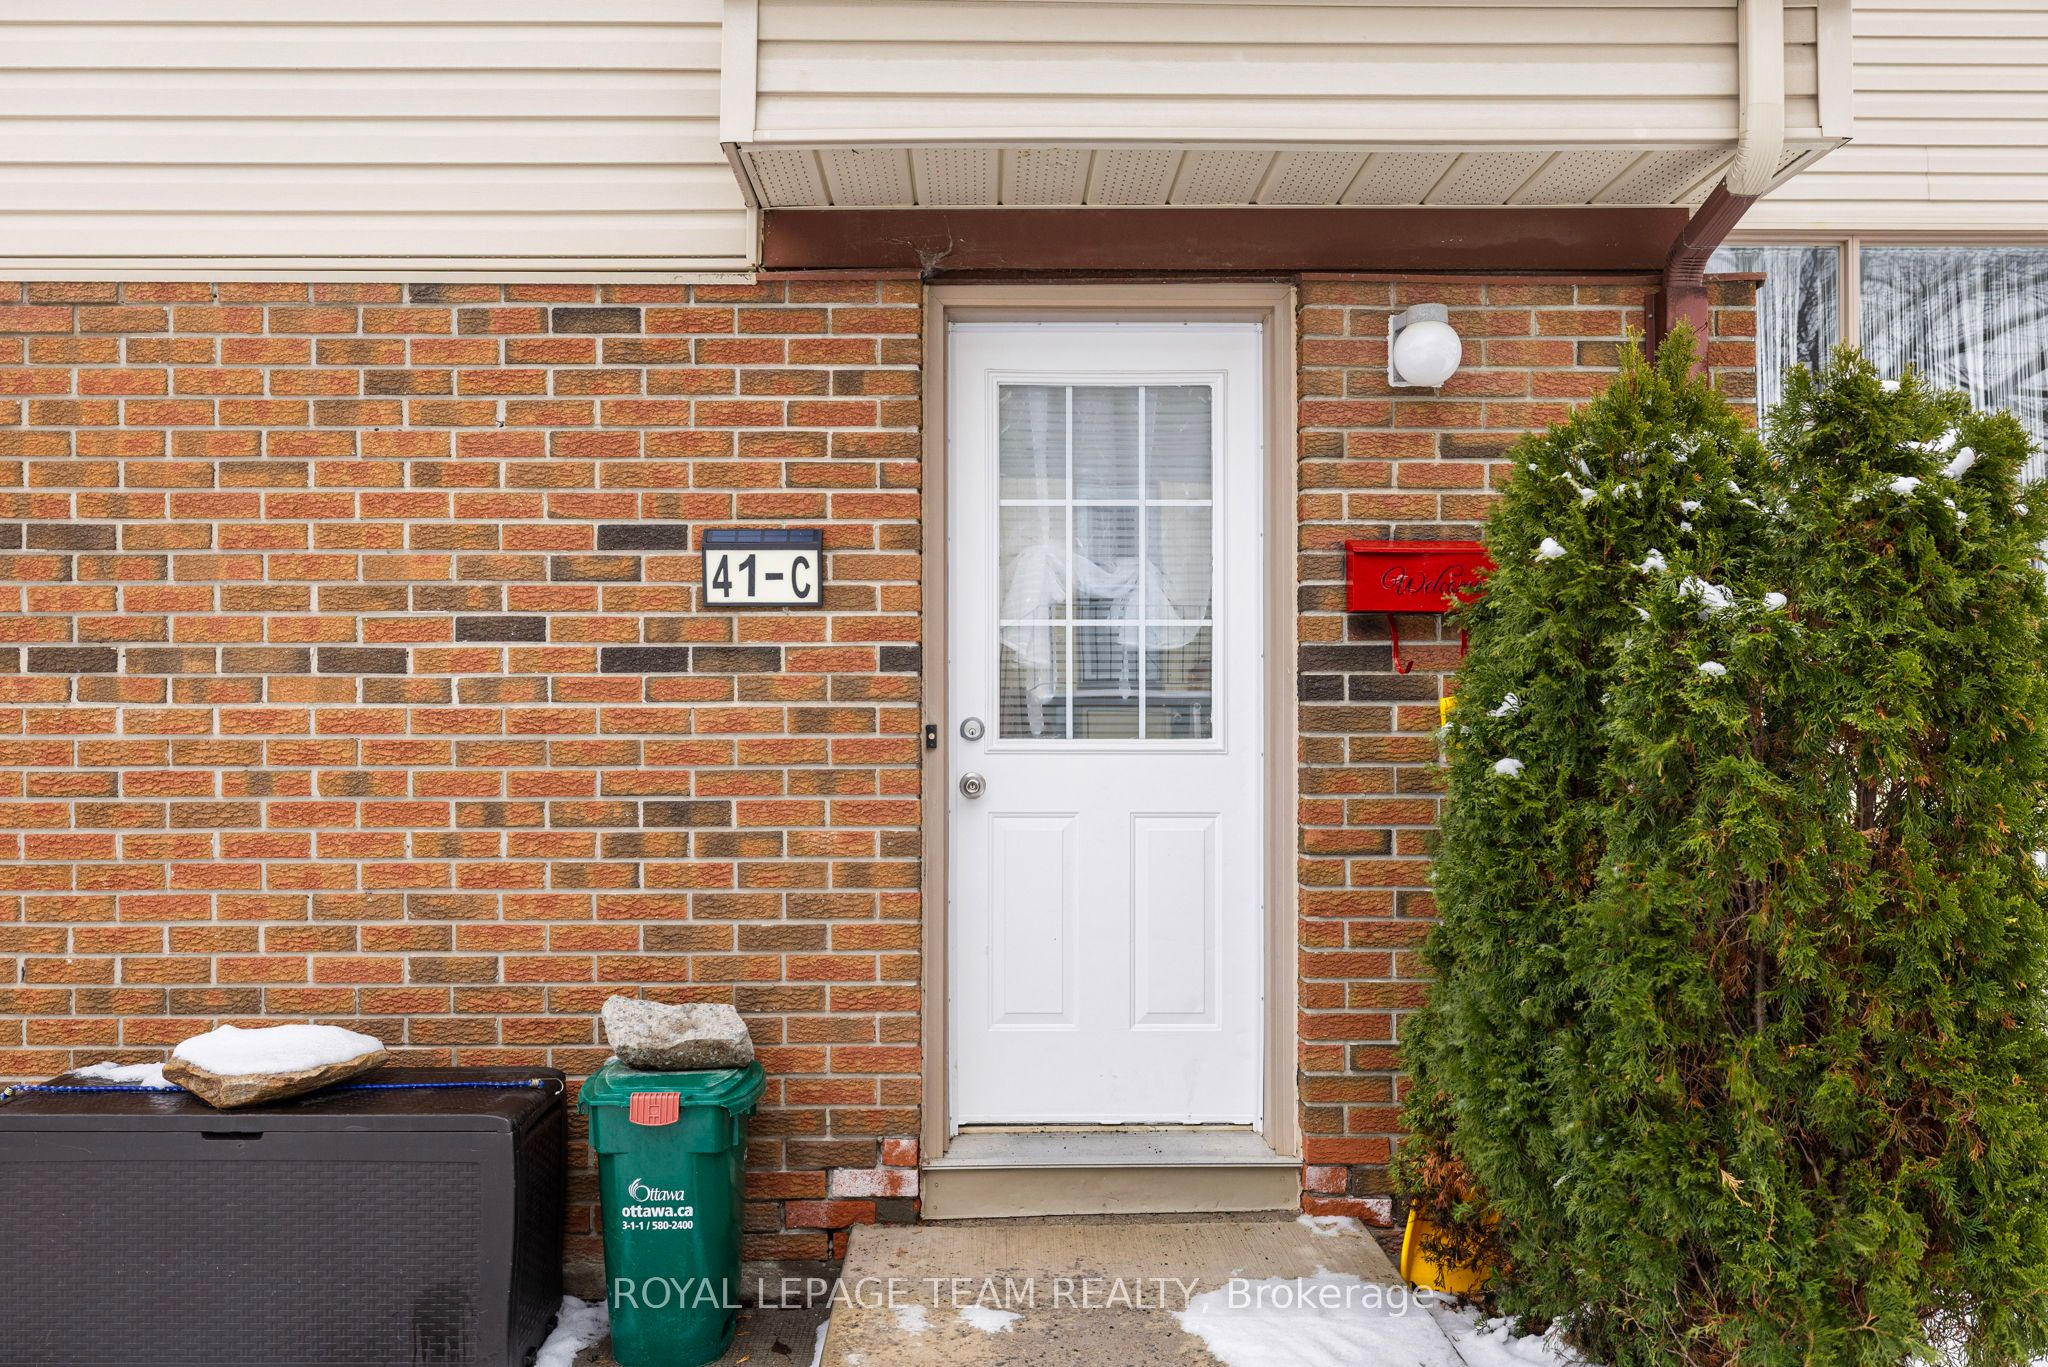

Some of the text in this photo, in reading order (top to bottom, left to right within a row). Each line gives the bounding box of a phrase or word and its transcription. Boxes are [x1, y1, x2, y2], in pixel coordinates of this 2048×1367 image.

[712, 554, 811, 598] 41-C
[1381, 564, 1483, 595] Welco
[628, 1178, 685, 1203] Ottawa
[621, 1205, 694, 1218] ottawa.ca
[622, 1221, 644, 1231] 3-1-1
[652, 1220, 694, 1230] 580-2400
